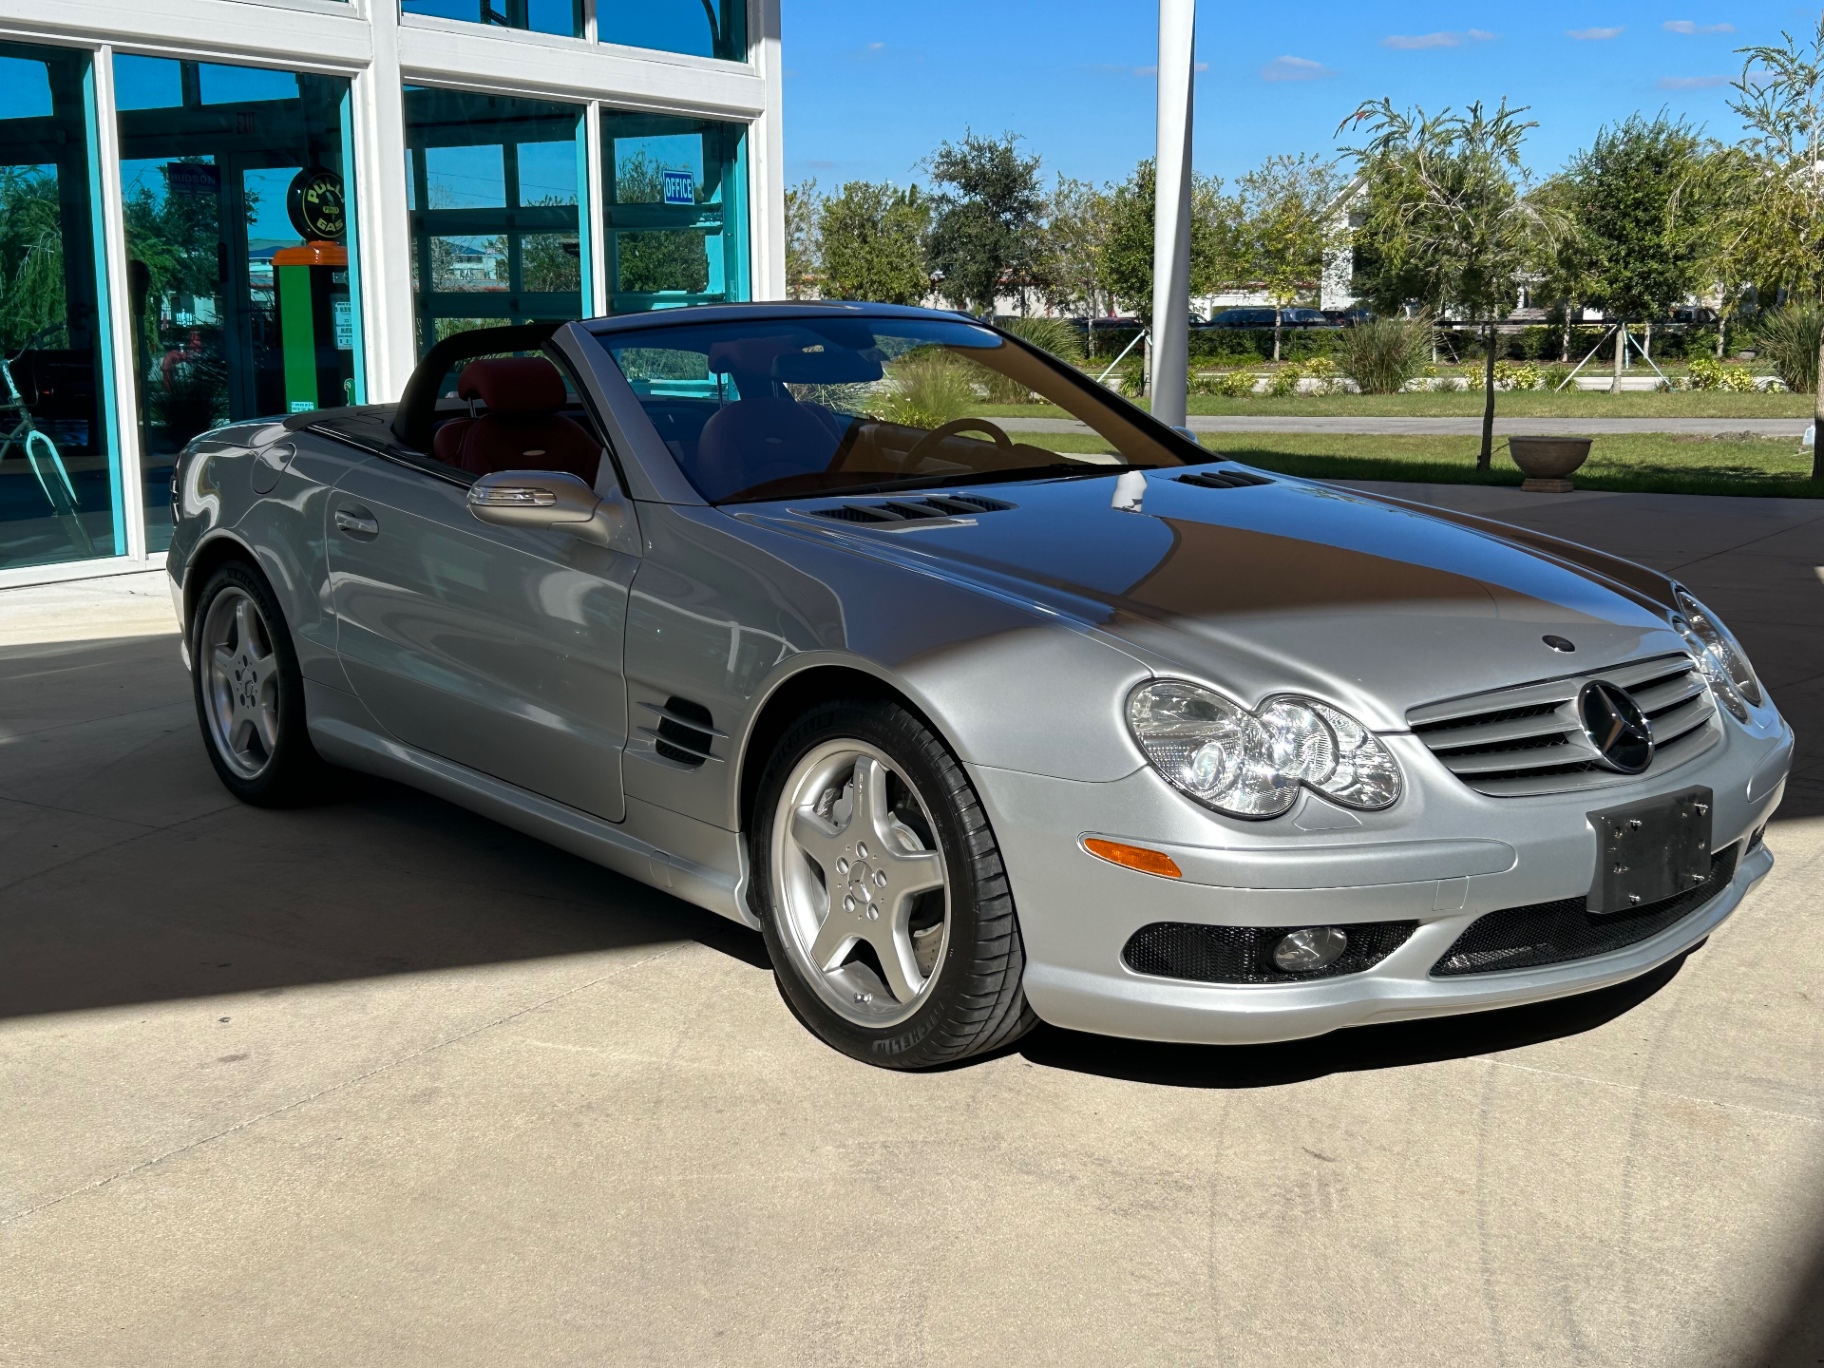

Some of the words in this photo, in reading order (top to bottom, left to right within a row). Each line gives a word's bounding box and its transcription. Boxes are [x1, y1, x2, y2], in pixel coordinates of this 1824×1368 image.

[237, 112, 256, 134] EXIT
[170, 173, 216, 185] HUDSON
[665, 177, 693, 199] OFFICE
[316, 218, 344, 232] GAS
